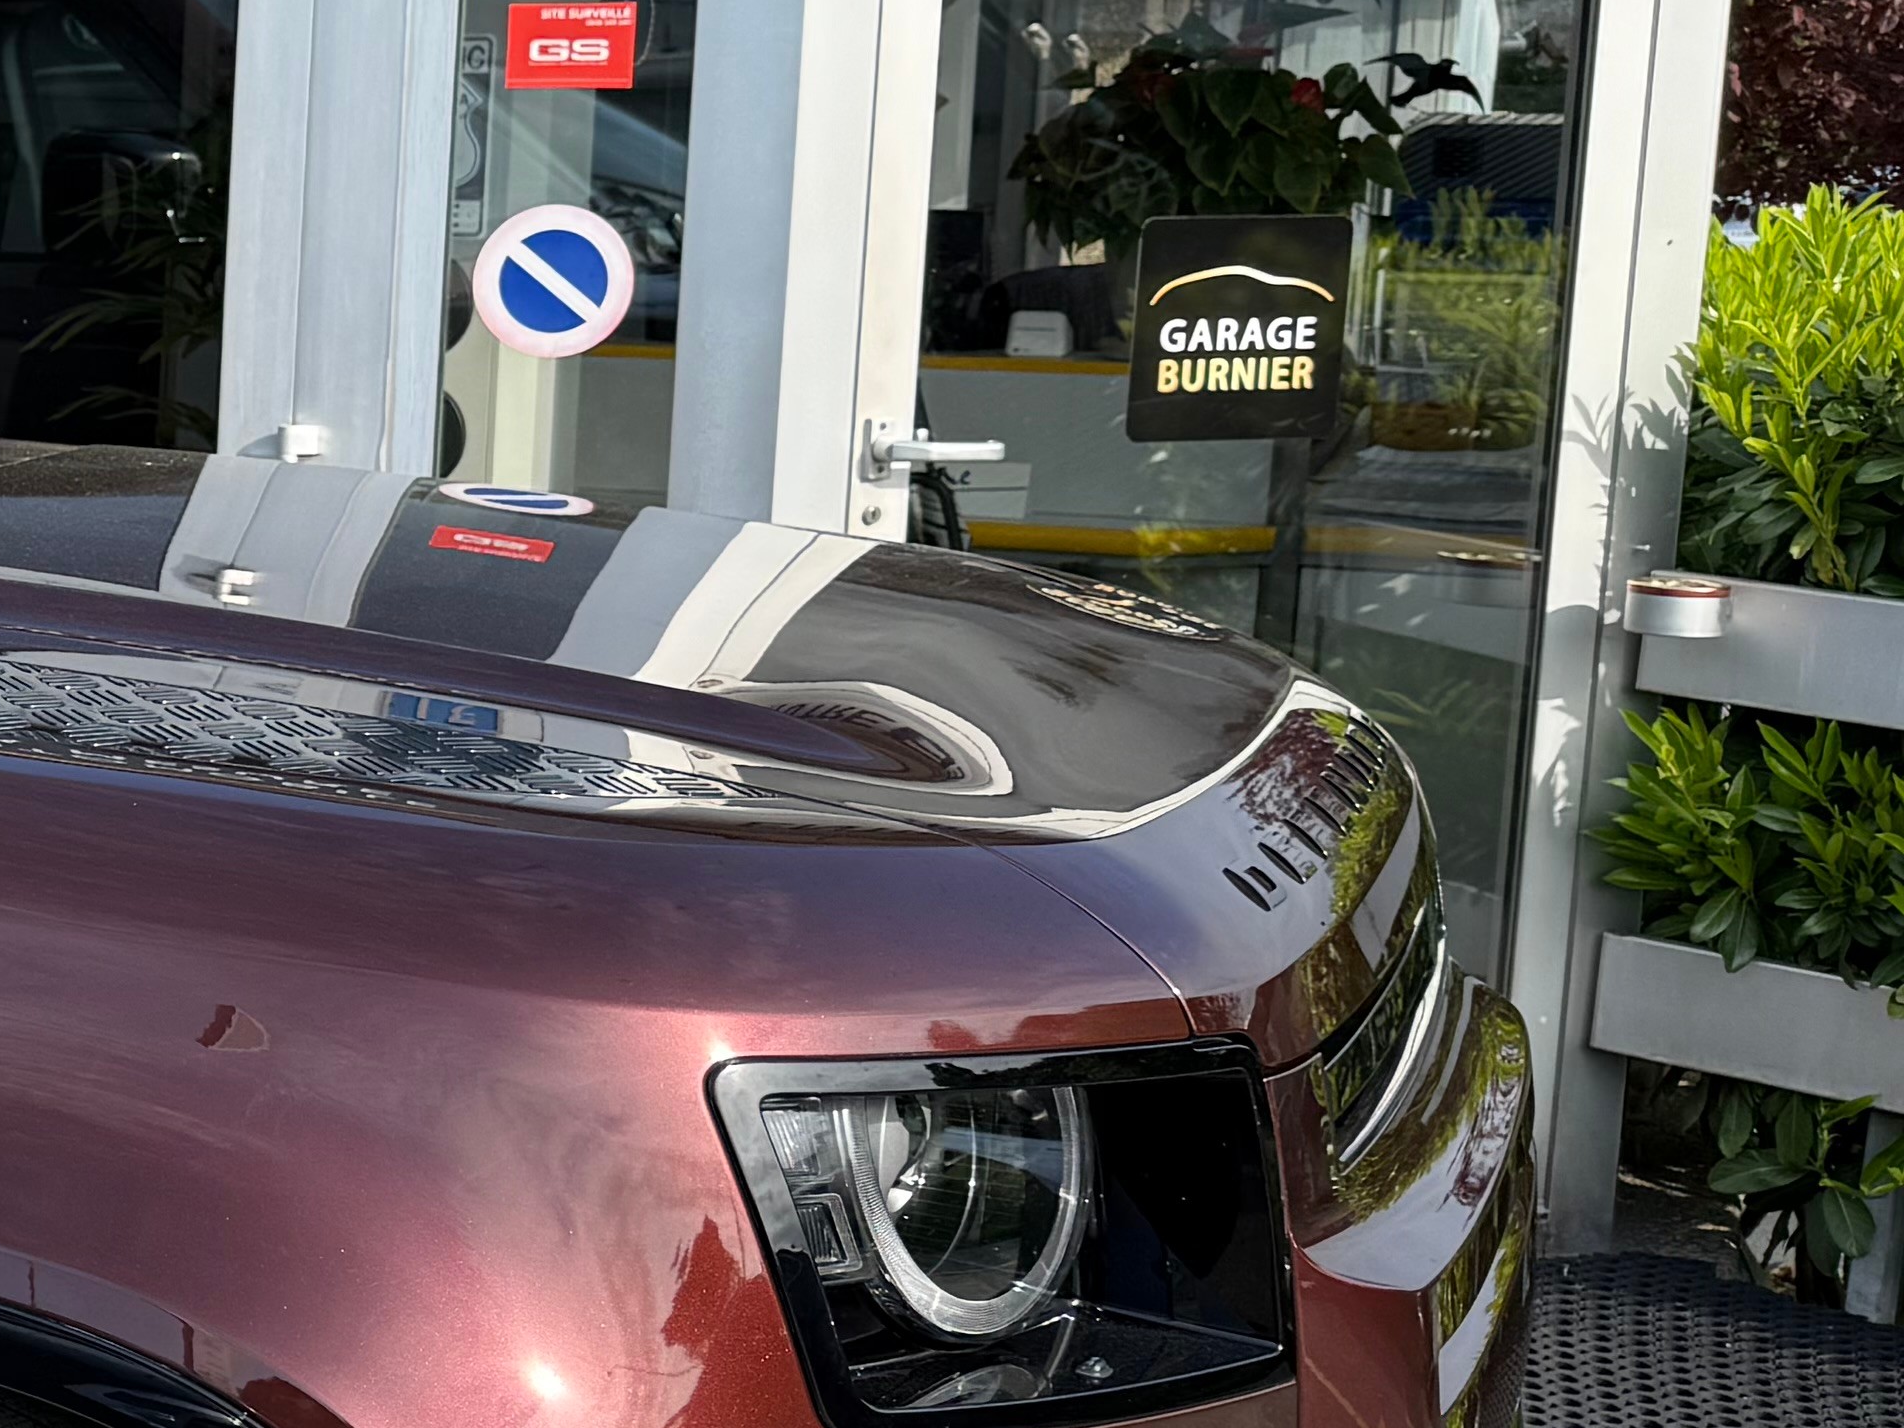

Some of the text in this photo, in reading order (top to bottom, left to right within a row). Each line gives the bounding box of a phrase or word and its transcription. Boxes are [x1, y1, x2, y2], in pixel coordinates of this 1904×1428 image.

[528, 38, 611, 63] GS
[1158, 314, 1318, 354] GARAGE
[1155, 353, 1316, 395] BURNIER
